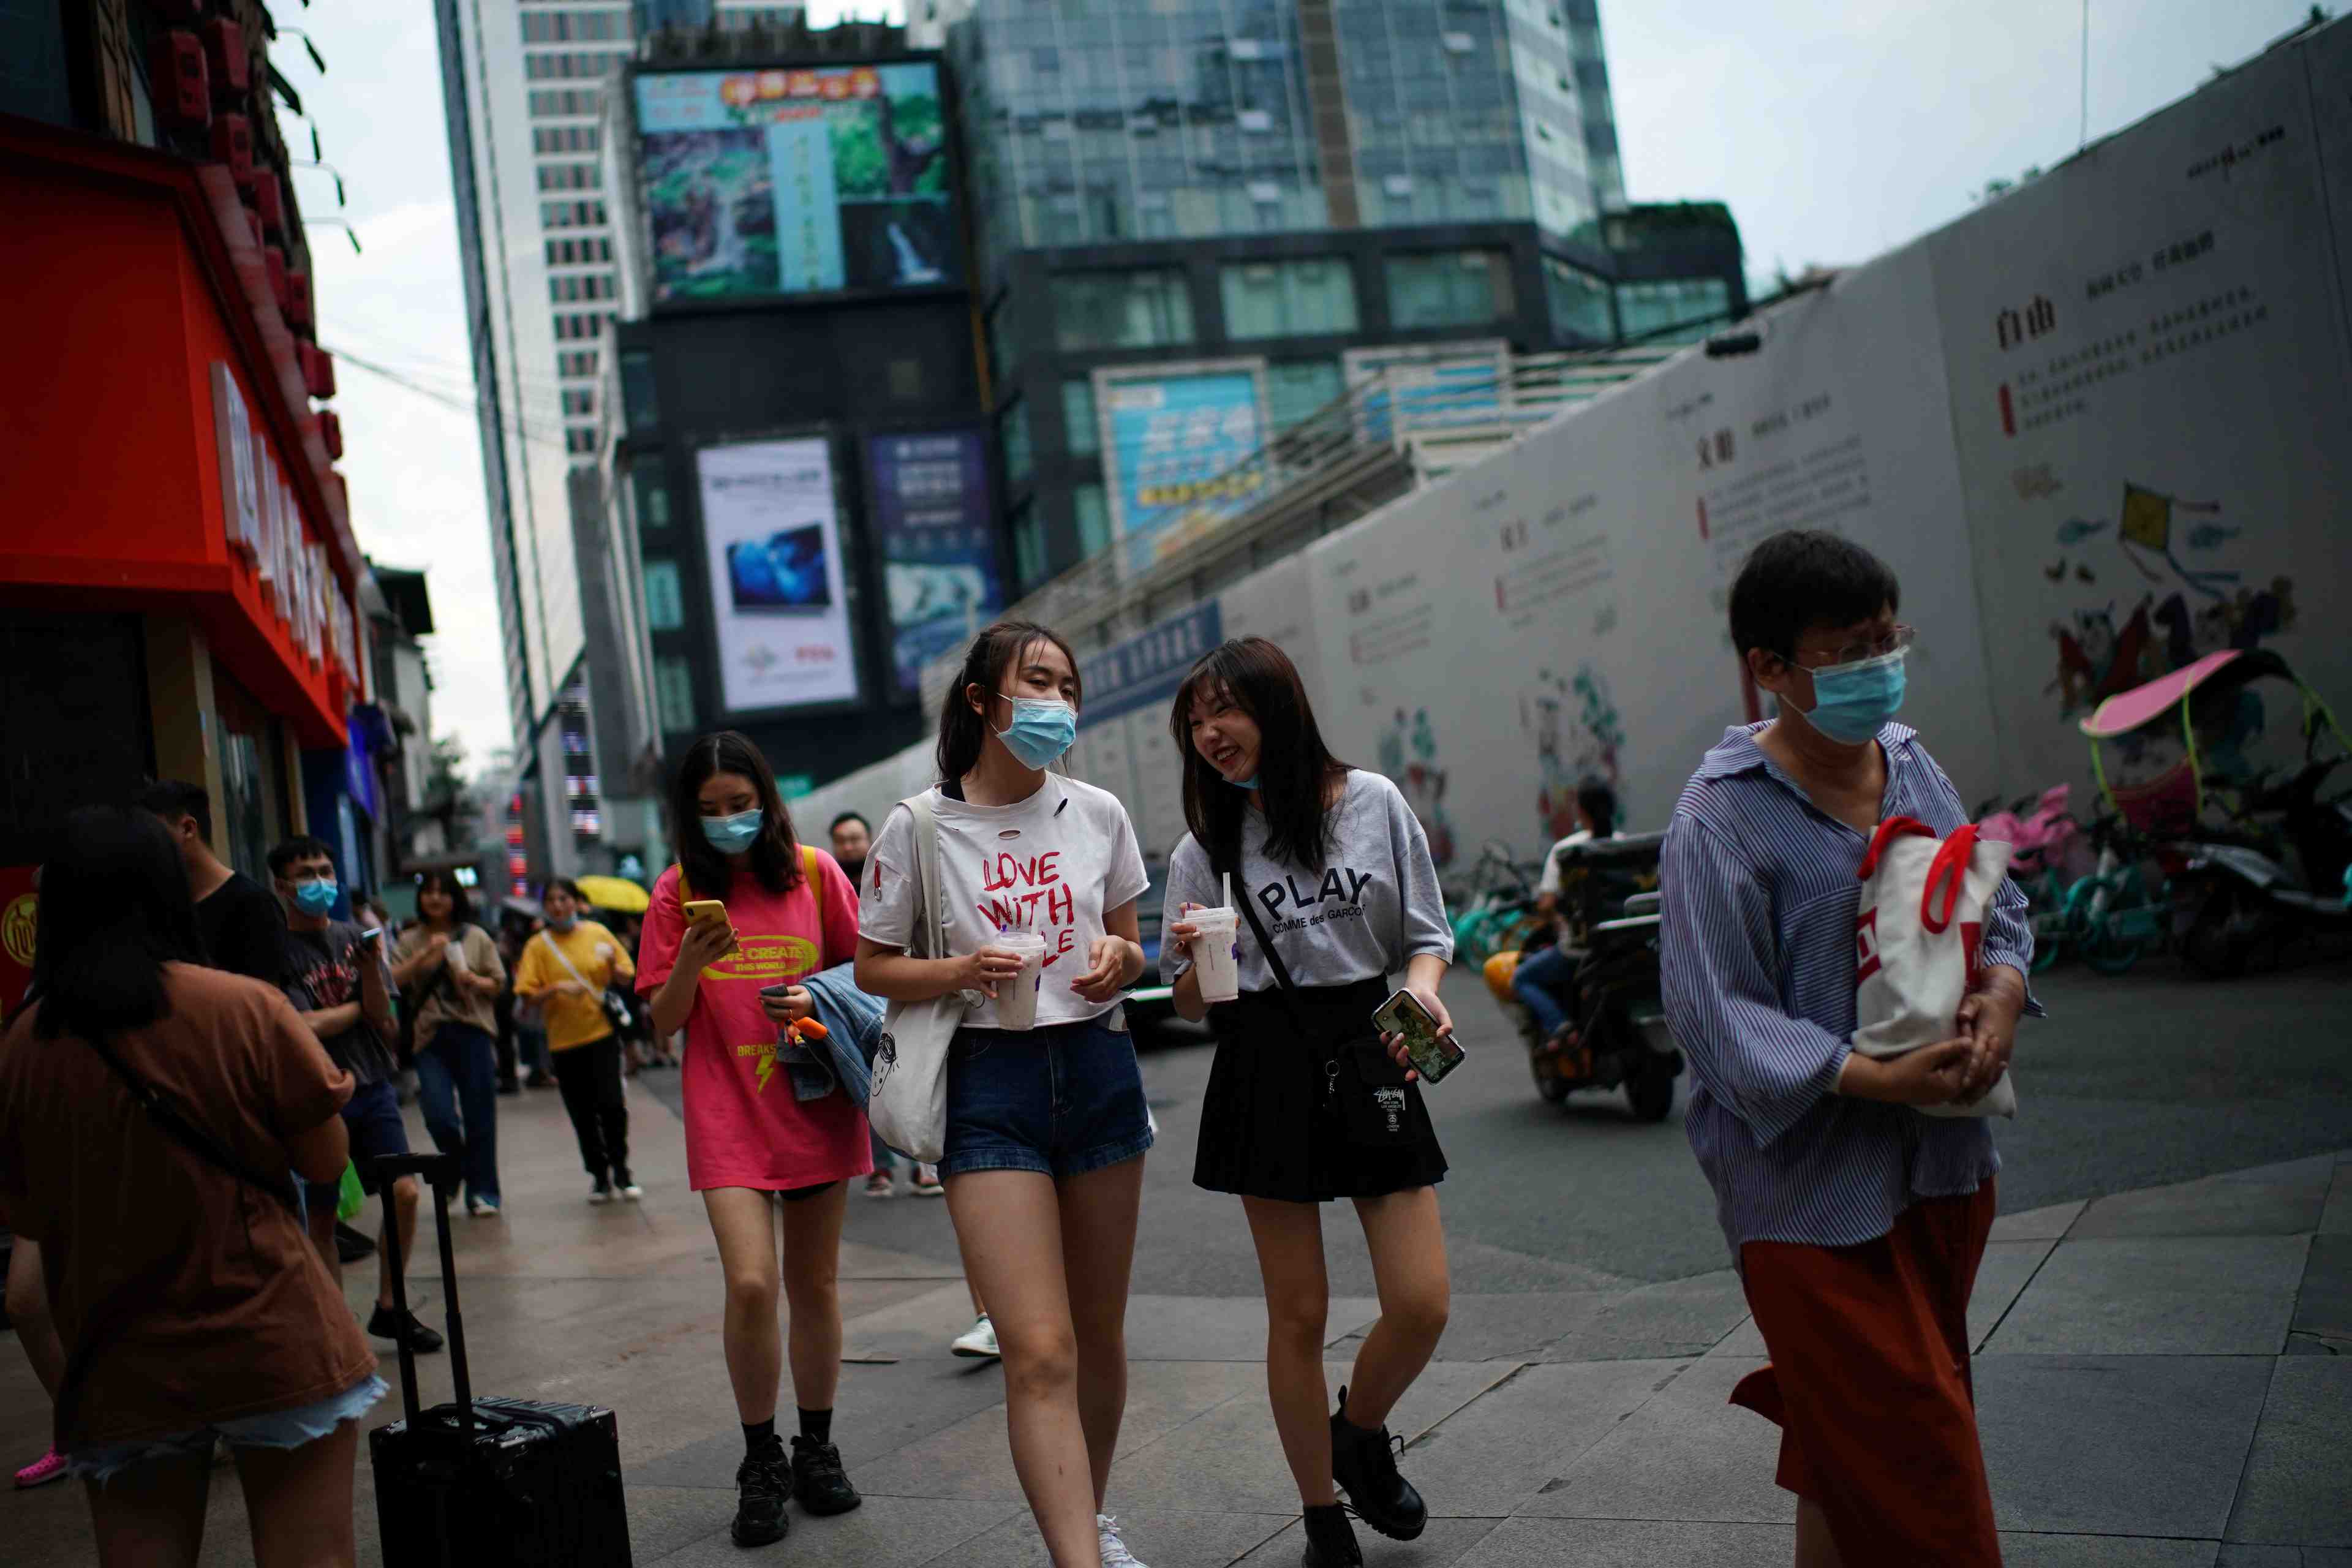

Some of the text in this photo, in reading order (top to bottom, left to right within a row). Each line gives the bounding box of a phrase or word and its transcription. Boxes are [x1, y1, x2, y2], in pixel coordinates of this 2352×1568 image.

[983, 852, 1060, 891] LOVE
[1257, 867, 1373, 922] PLAY
[1272, 903, 1366, 934] COMME des GARÇO
